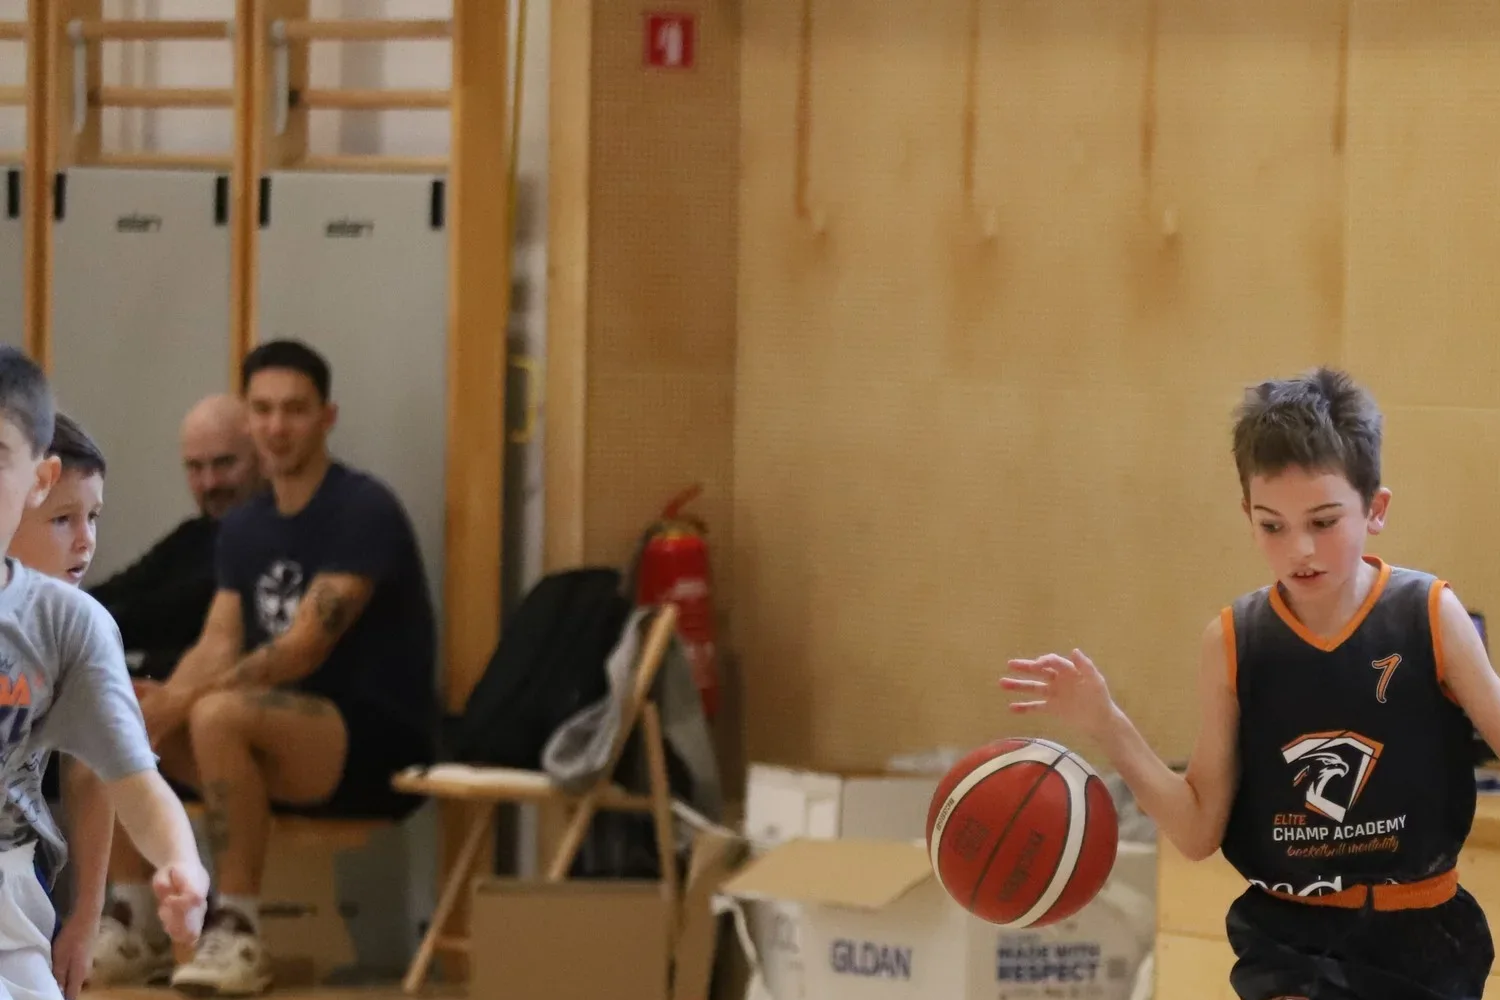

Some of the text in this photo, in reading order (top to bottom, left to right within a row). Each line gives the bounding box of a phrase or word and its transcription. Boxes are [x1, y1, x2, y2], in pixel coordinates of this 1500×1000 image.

[1371, 653, 1402, 703] 7
[1273, 815, 1406, 841] CHAMP ACADEMY
[829, 938, 913, 981] GILDAN
